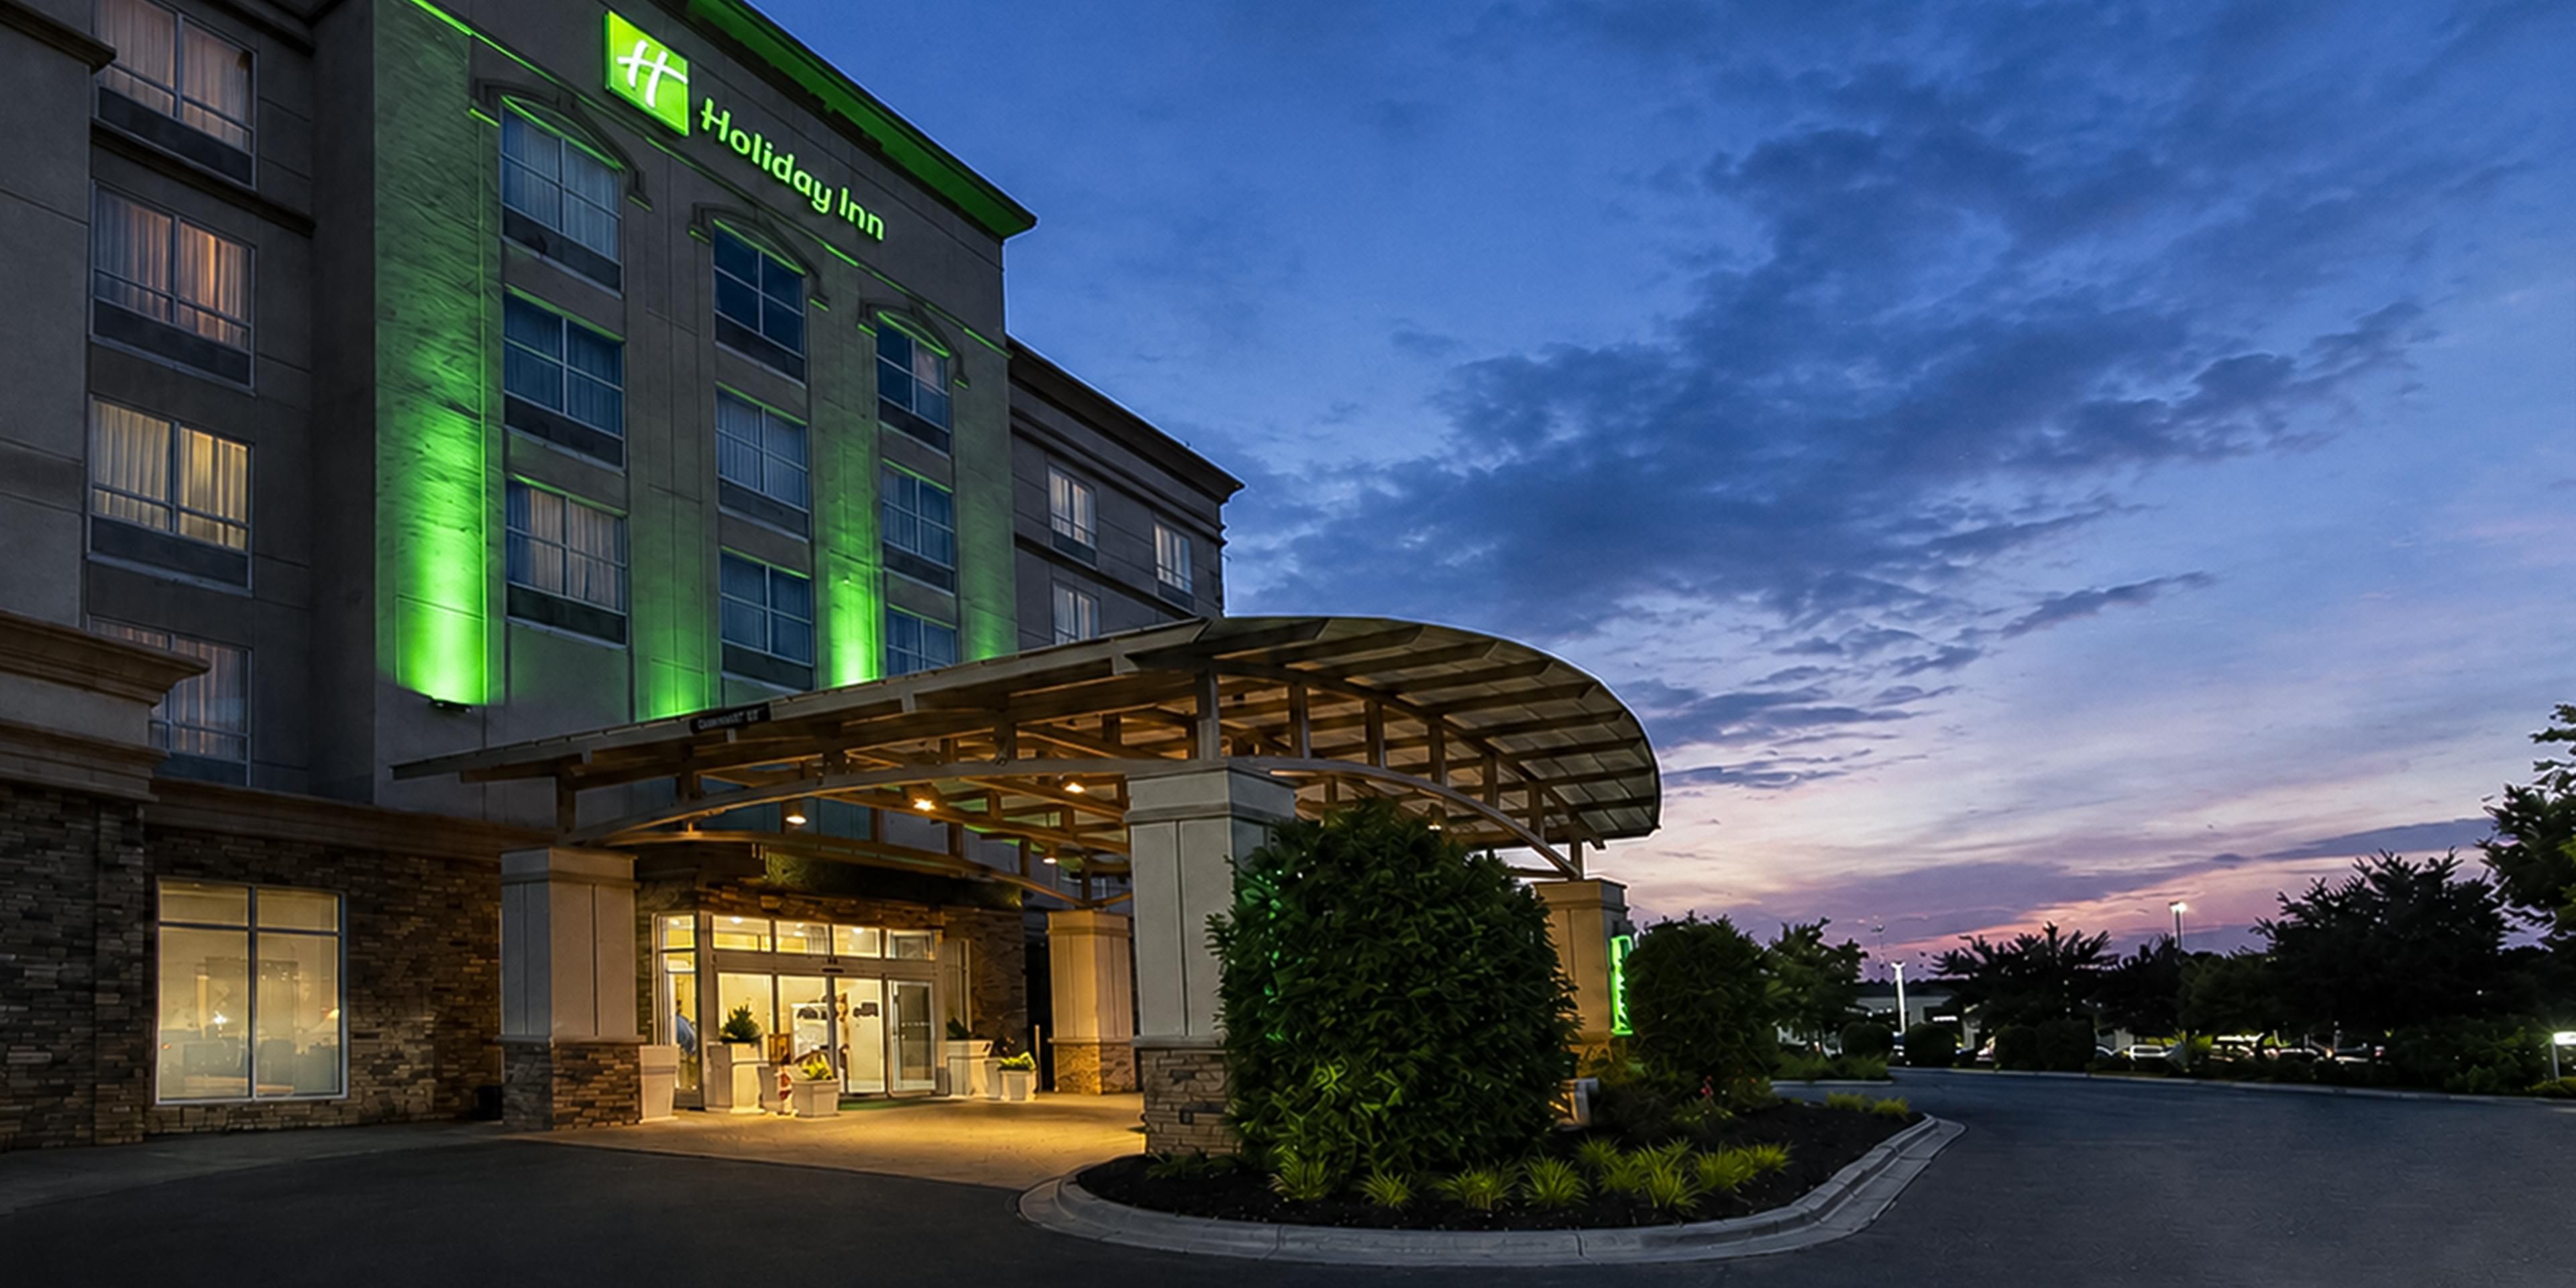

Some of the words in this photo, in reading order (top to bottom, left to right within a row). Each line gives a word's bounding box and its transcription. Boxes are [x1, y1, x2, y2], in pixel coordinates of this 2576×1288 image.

[617, 40, 688, 108] H
[700, 98, 832, 215] Holiday
[839, 187, 884, 240] Inn
